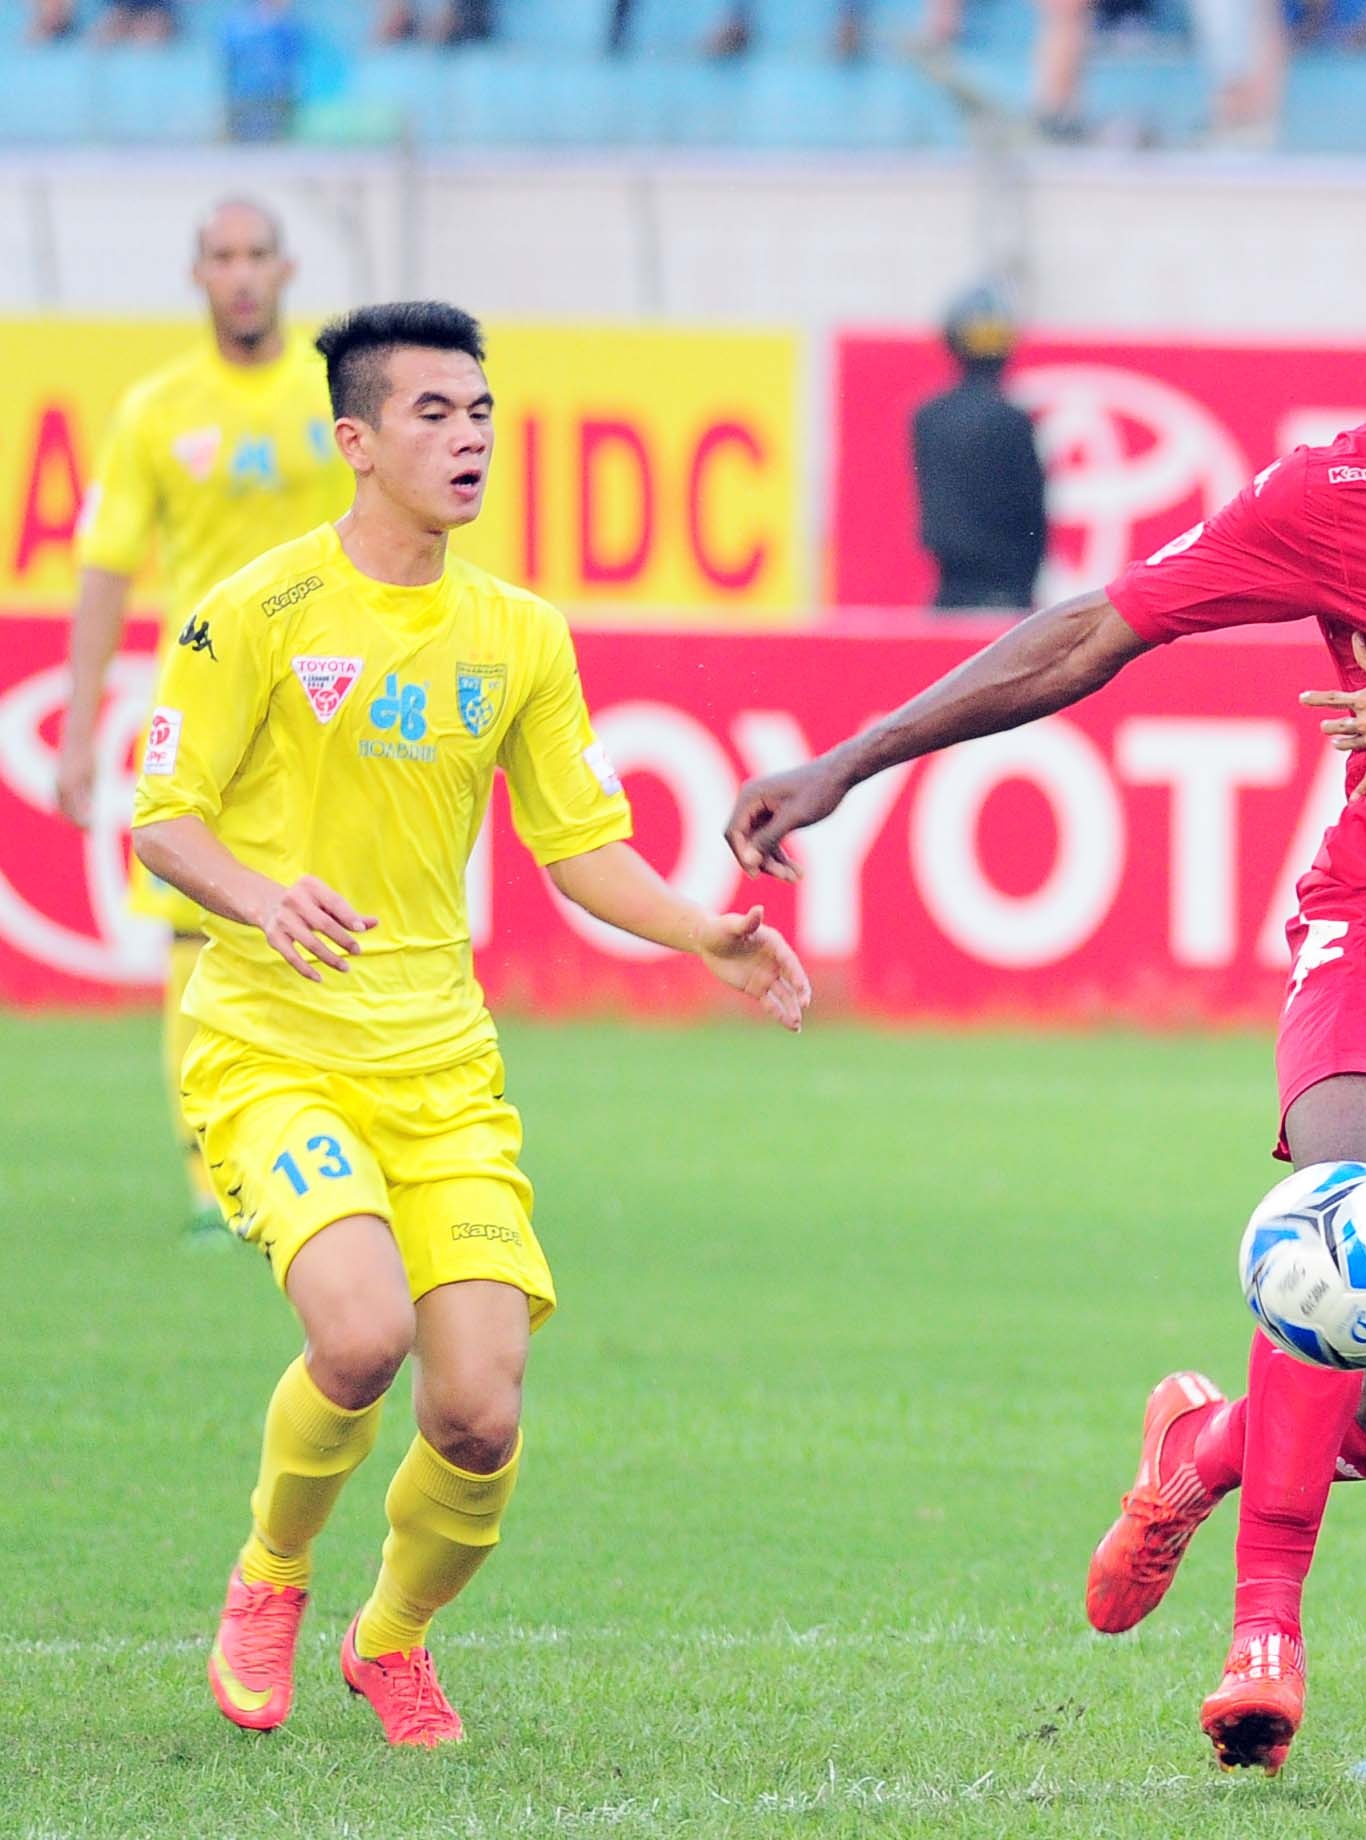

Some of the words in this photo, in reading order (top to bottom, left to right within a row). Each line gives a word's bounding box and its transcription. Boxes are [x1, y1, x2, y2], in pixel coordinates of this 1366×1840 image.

[519, 414, 770, 593] IDC
[261, 576, 324, 617] Kappa
[297, 660, 357, 673] TOYOTA
[272, 1134, 353, 1196] 13
